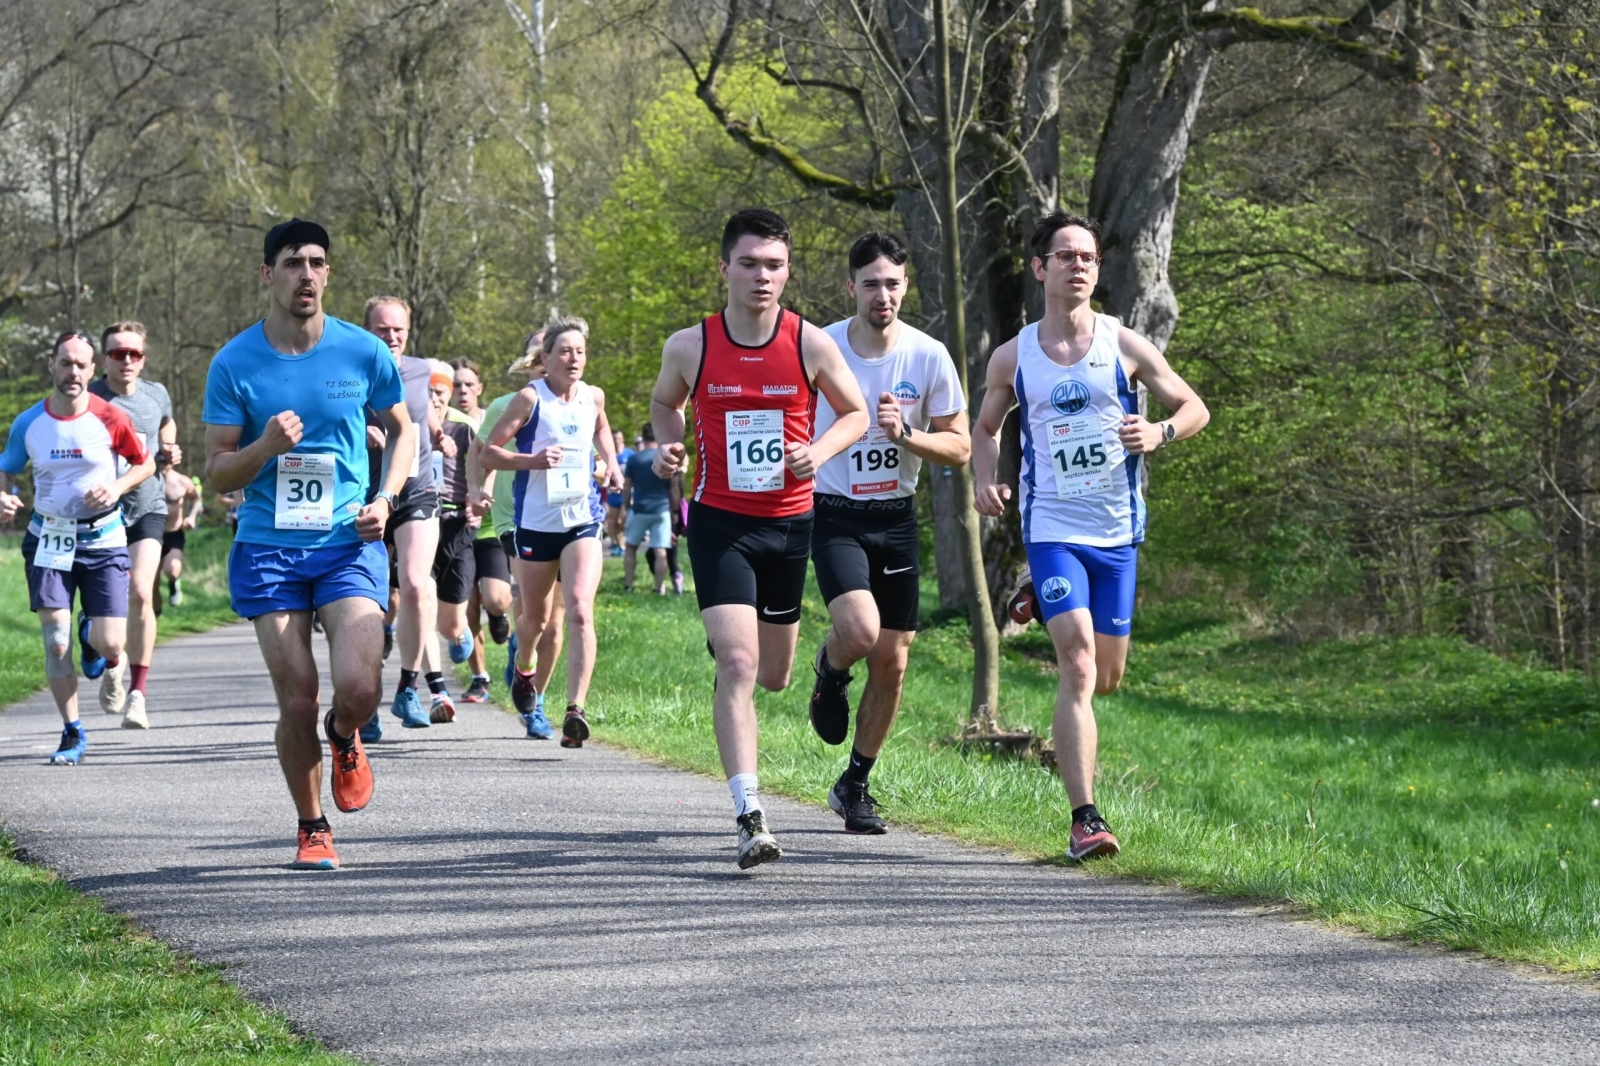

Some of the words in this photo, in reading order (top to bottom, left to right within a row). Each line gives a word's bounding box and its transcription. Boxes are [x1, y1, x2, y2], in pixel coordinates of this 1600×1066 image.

[325, 380, 335, 388] TJ
[338, 380, 361, 388] SOKOL
[708, 383, 742, 394] Krakonoš
[763, 384, 798, 392] MARATON
[327, 390, 361, 400] OLEŠNICE
[891, 391, 921, 400] TLETIKA
[732, 419, 751, 427] CUP
[1053, 427, 1071, 437] CUP
[729, 438, 783, 465] 166
[850, 447, 899, 472] 198
[1053, 442, 1107, 472] 145
[284, 460, 302, 468] CUP
[561, 472, 570, 489] 1
[1063, 472, 1085, 480] VOJTĚCH
[286, 478, 323, 503] 30
[856, 484, 881, 492] PRIMATOR
[818, 495, 867, 509] NIKE
[867, 500, 907, 511] PRO
[41, 532, 75, 553] 119
